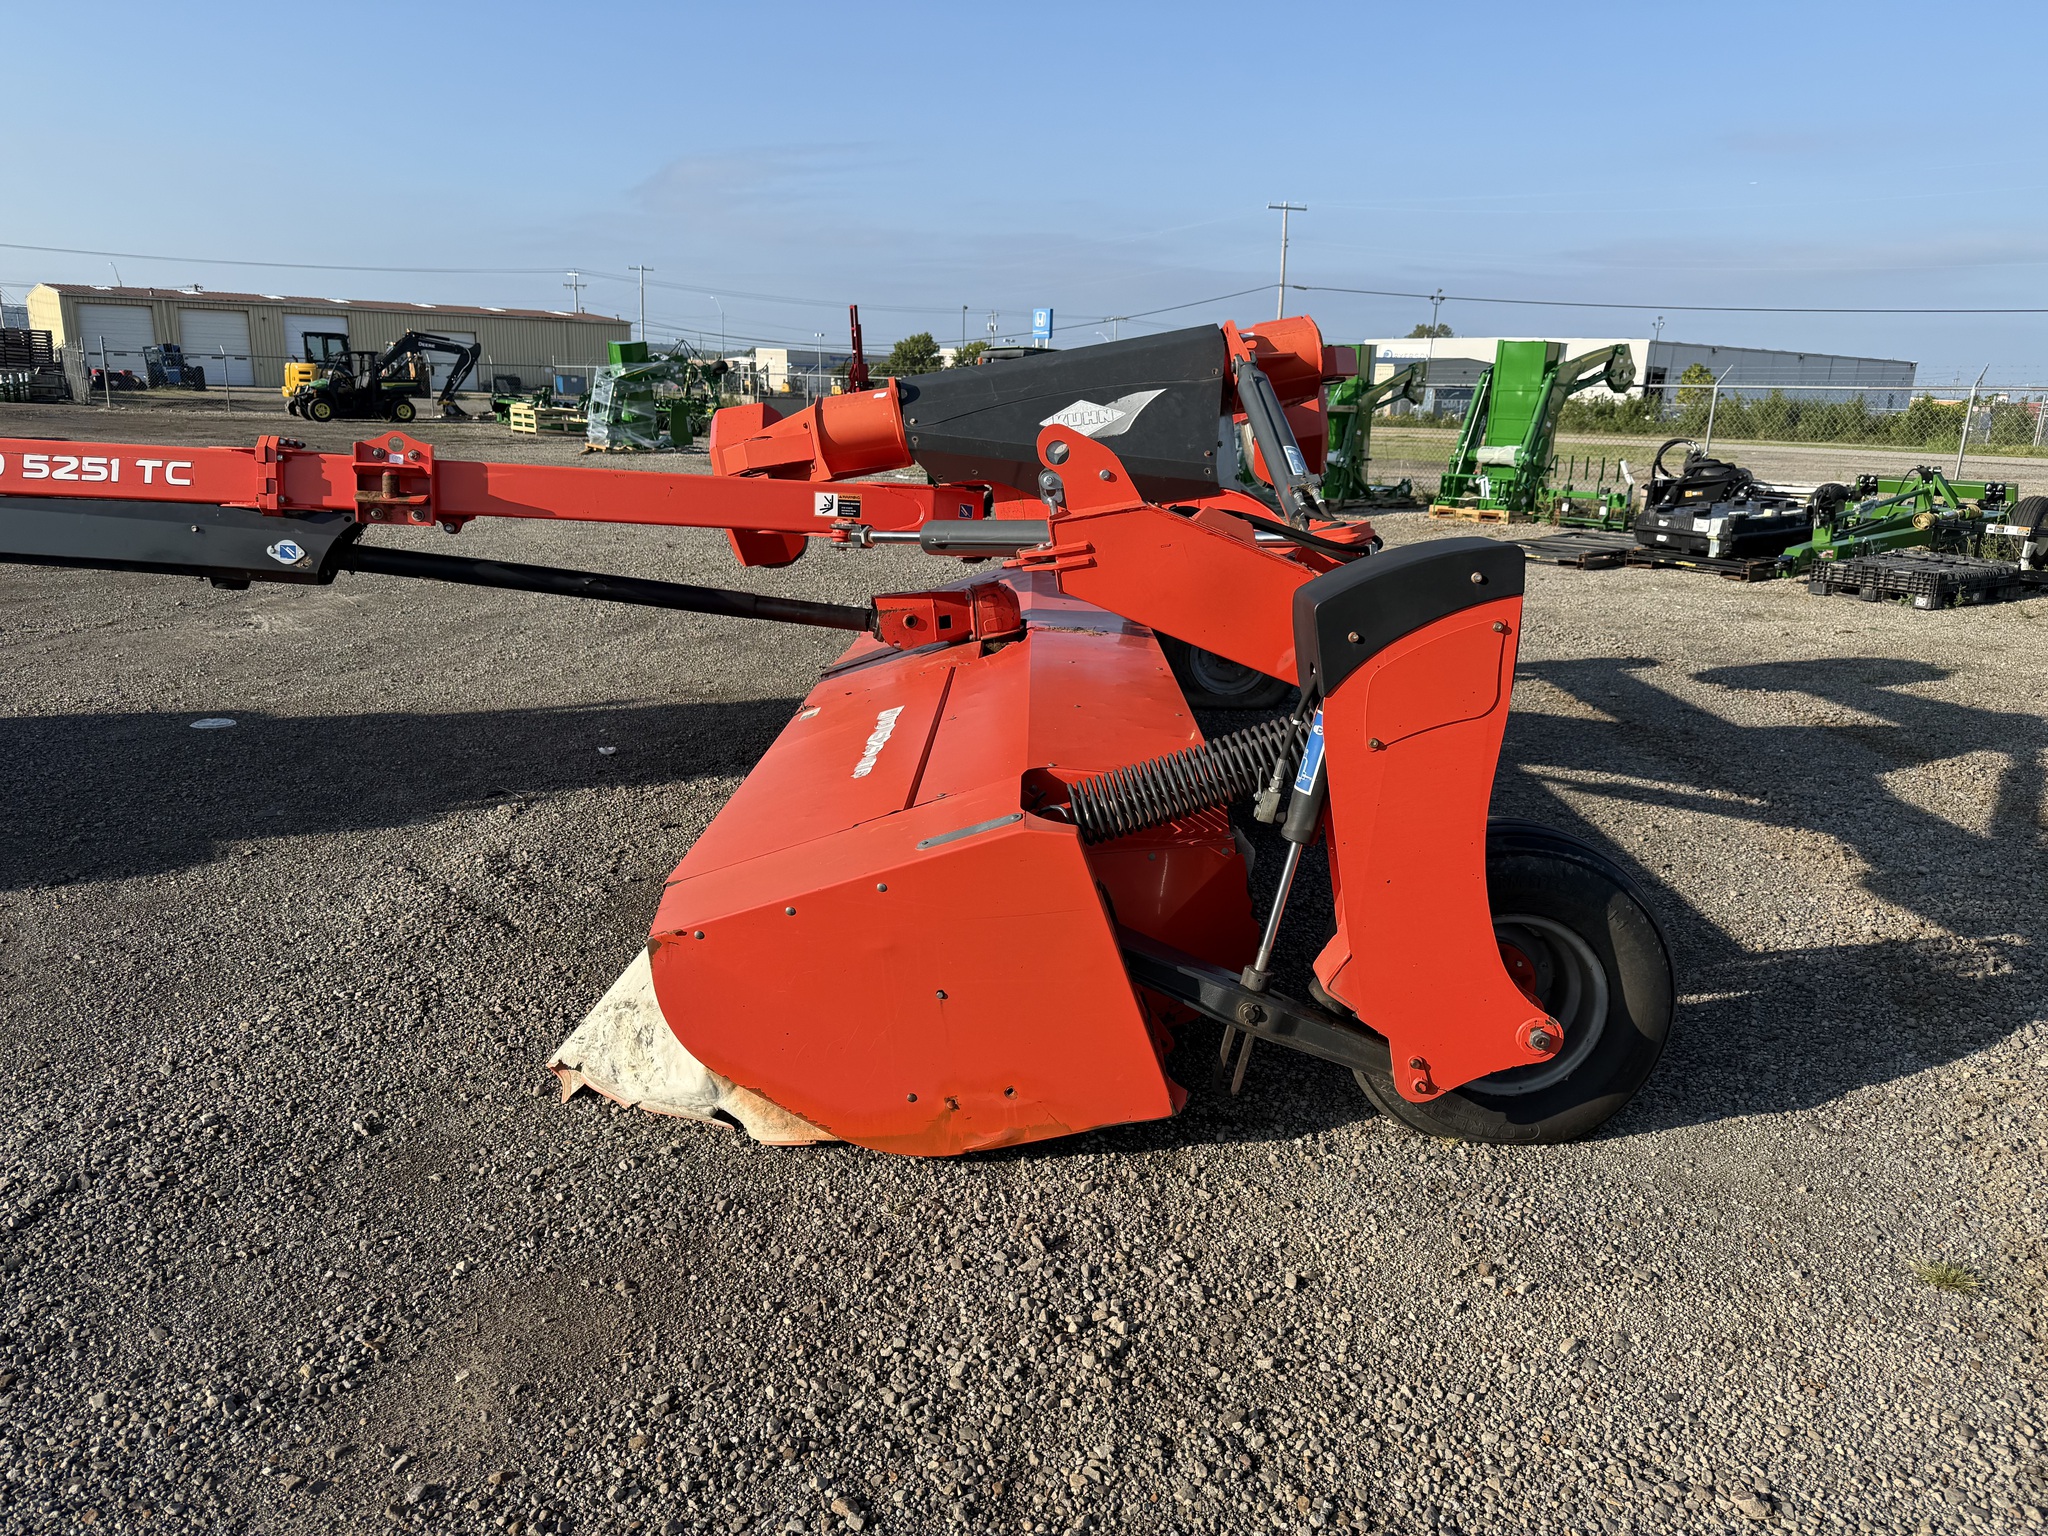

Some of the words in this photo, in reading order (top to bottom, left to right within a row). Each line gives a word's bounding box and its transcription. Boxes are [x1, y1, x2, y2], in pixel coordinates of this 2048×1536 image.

[417, 341, 436, 349] DEERE
[1052, 408, 1115, 427] KUHN
[22, 453, 120, 483] 5251
[135, 458, 192, 486] TC
